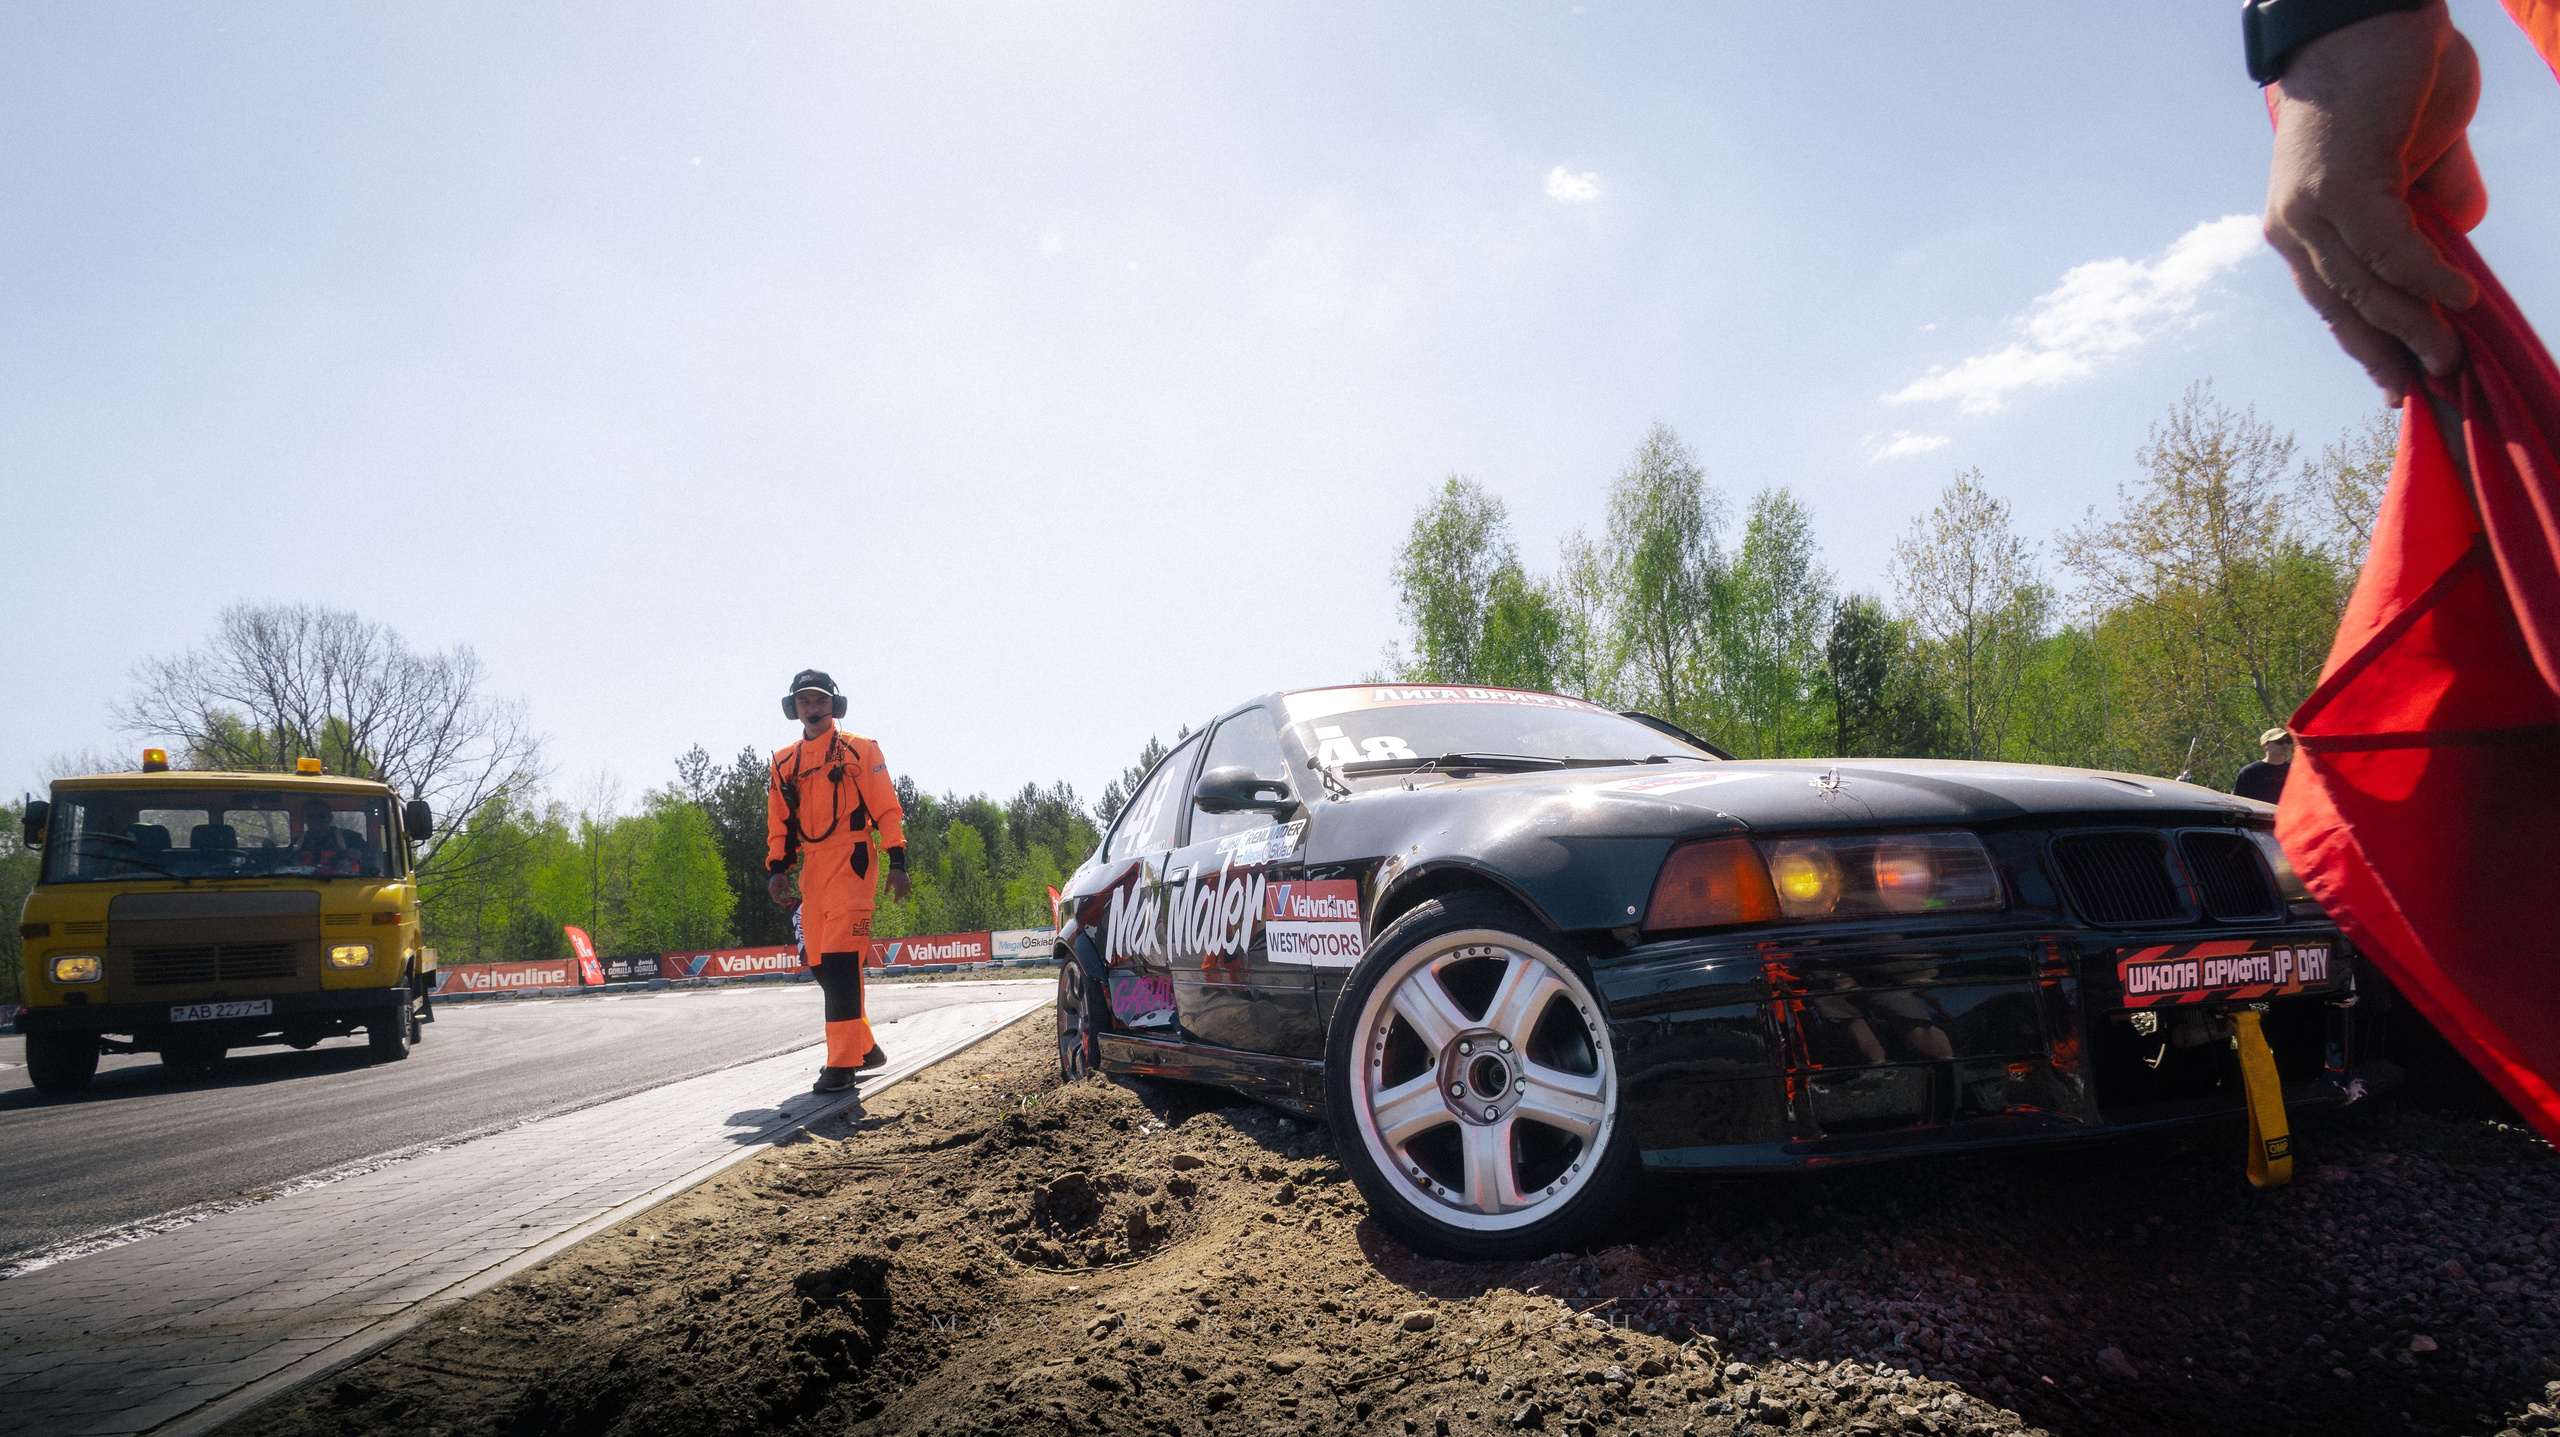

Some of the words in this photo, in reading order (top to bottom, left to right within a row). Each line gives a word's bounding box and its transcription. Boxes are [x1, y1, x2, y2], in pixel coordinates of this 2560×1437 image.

[1314, 725, 1419, 769] 48
[1122, 766, 1175, 854] 48
[1290, 894, 1357, 919] Valvoline
[1105, 876, 1162, 963] Max
[907, 941, 981, 961] Valvoline
[1268, 932, 1361, 956] WESTMOTORS
[461, 968, 566, 989] Valvoline
[608, 966, 632, 975] GORILLA
[634, 964, 658, 973] GORILLA
[2128, 962, 2198, 993] ШКОЛА
[2204, 956, 2270, 986] ДРИФТА
[2274, 950, 2292, 983] JP
[2297, 948, 2328, 982] DAY
[188, 1005, 212, 1019] AB
[2269, 1141, 2288, 1154] OMP
